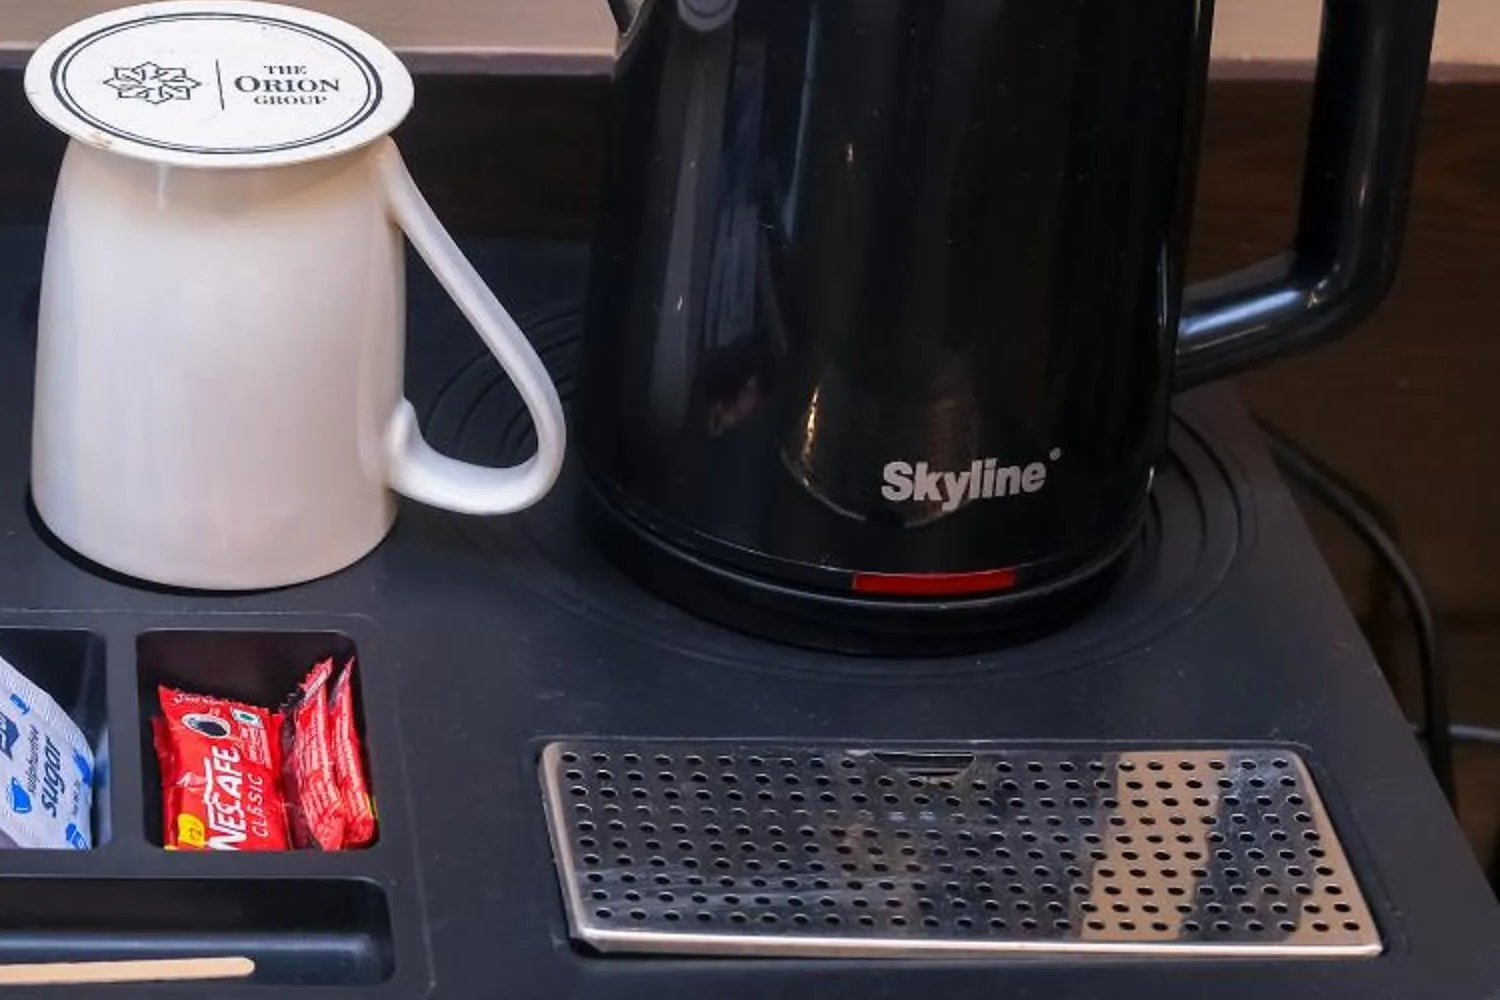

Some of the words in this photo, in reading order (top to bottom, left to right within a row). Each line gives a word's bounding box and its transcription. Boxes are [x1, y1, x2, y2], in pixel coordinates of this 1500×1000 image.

[263, 65, 307, 75] THE
[234, 75, 340, 93] ORION
[253, 95, 328, 105] GROUP
[881, 457, 1047, 512] Skyline
[41, 736, 66, 818] sugar
